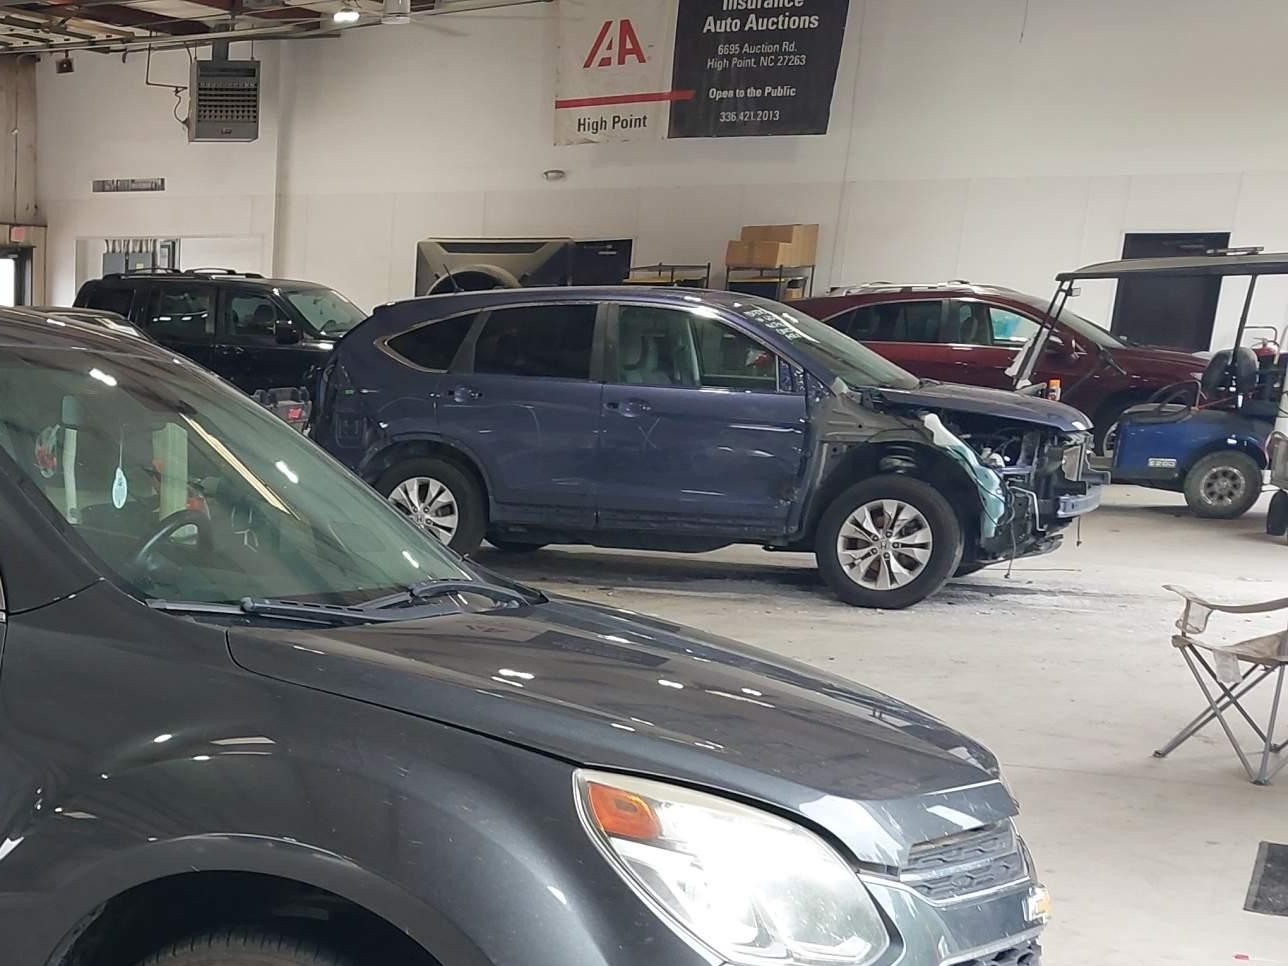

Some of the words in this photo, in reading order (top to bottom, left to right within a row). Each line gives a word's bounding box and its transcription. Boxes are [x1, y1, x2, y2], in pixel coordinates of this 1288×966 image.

[703, 16, 741, 33] Auto
[744, 12, 820, 31] Auctions
[718, 44, 740, 55] 6695
[742, 42, 780, 54] Auction
[782, 41, 798, 52] Rd.
[707, 58, 729, 71] High
[760, 56, 775, 67] NC
[777, 54, 806, 66] 27263
[709, 87, 734, 101] Open
[736, 88, 745, 98] to
[747, 87, 762, 98] the
[764, 85, 797, 97] Public
[577, 116, 607, 134] High
[612, 114, 648, 130] Point
